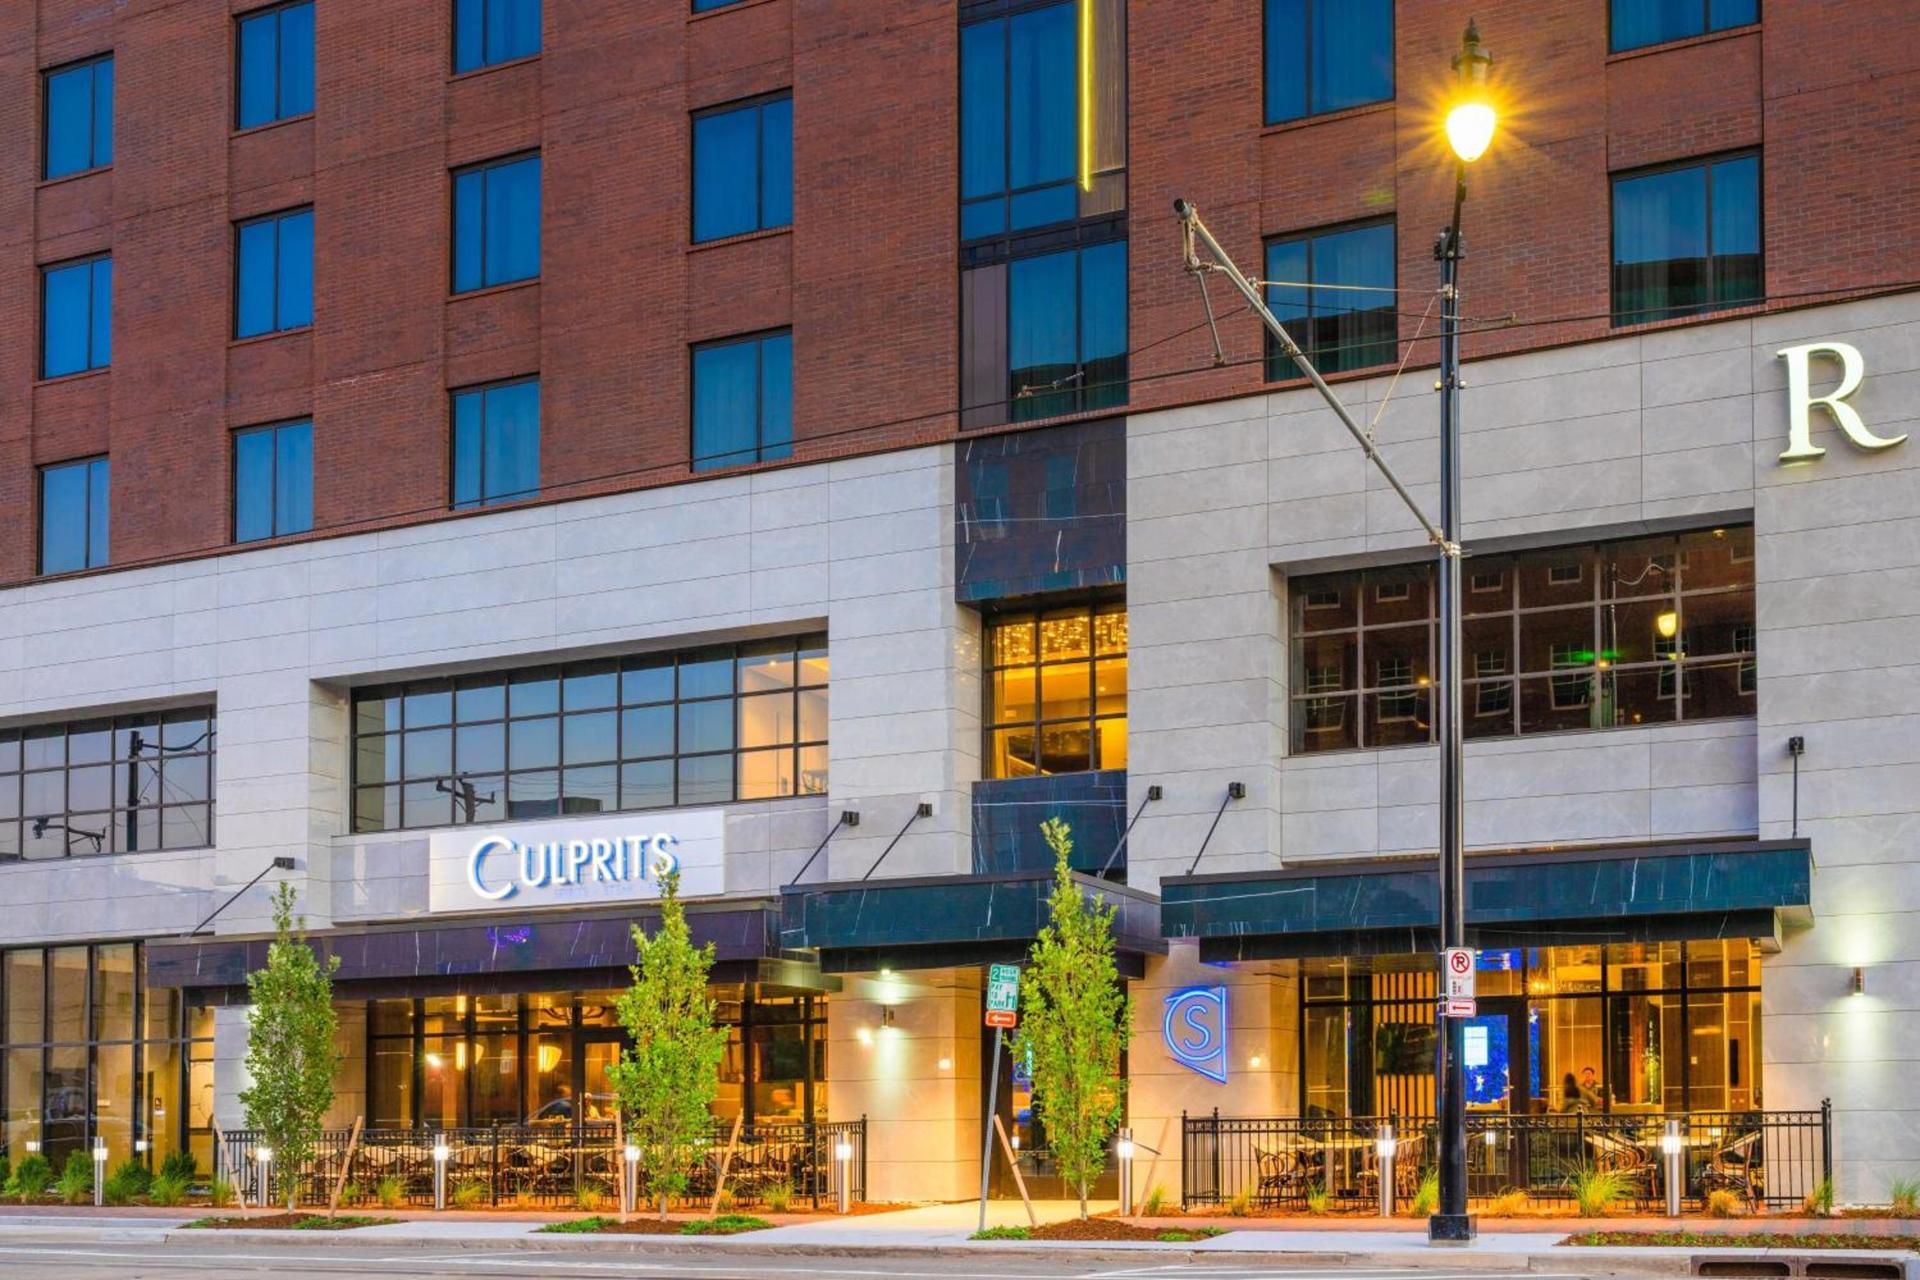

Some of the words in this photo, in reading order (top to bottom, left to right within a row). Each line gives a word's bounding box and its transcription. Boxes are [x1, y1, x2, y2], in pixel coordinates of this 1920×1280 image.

[1776, 342, 1909, 462] R
[467, 833, 679, 900] CULPRITS
[992, 968, 1000, 980] 2
